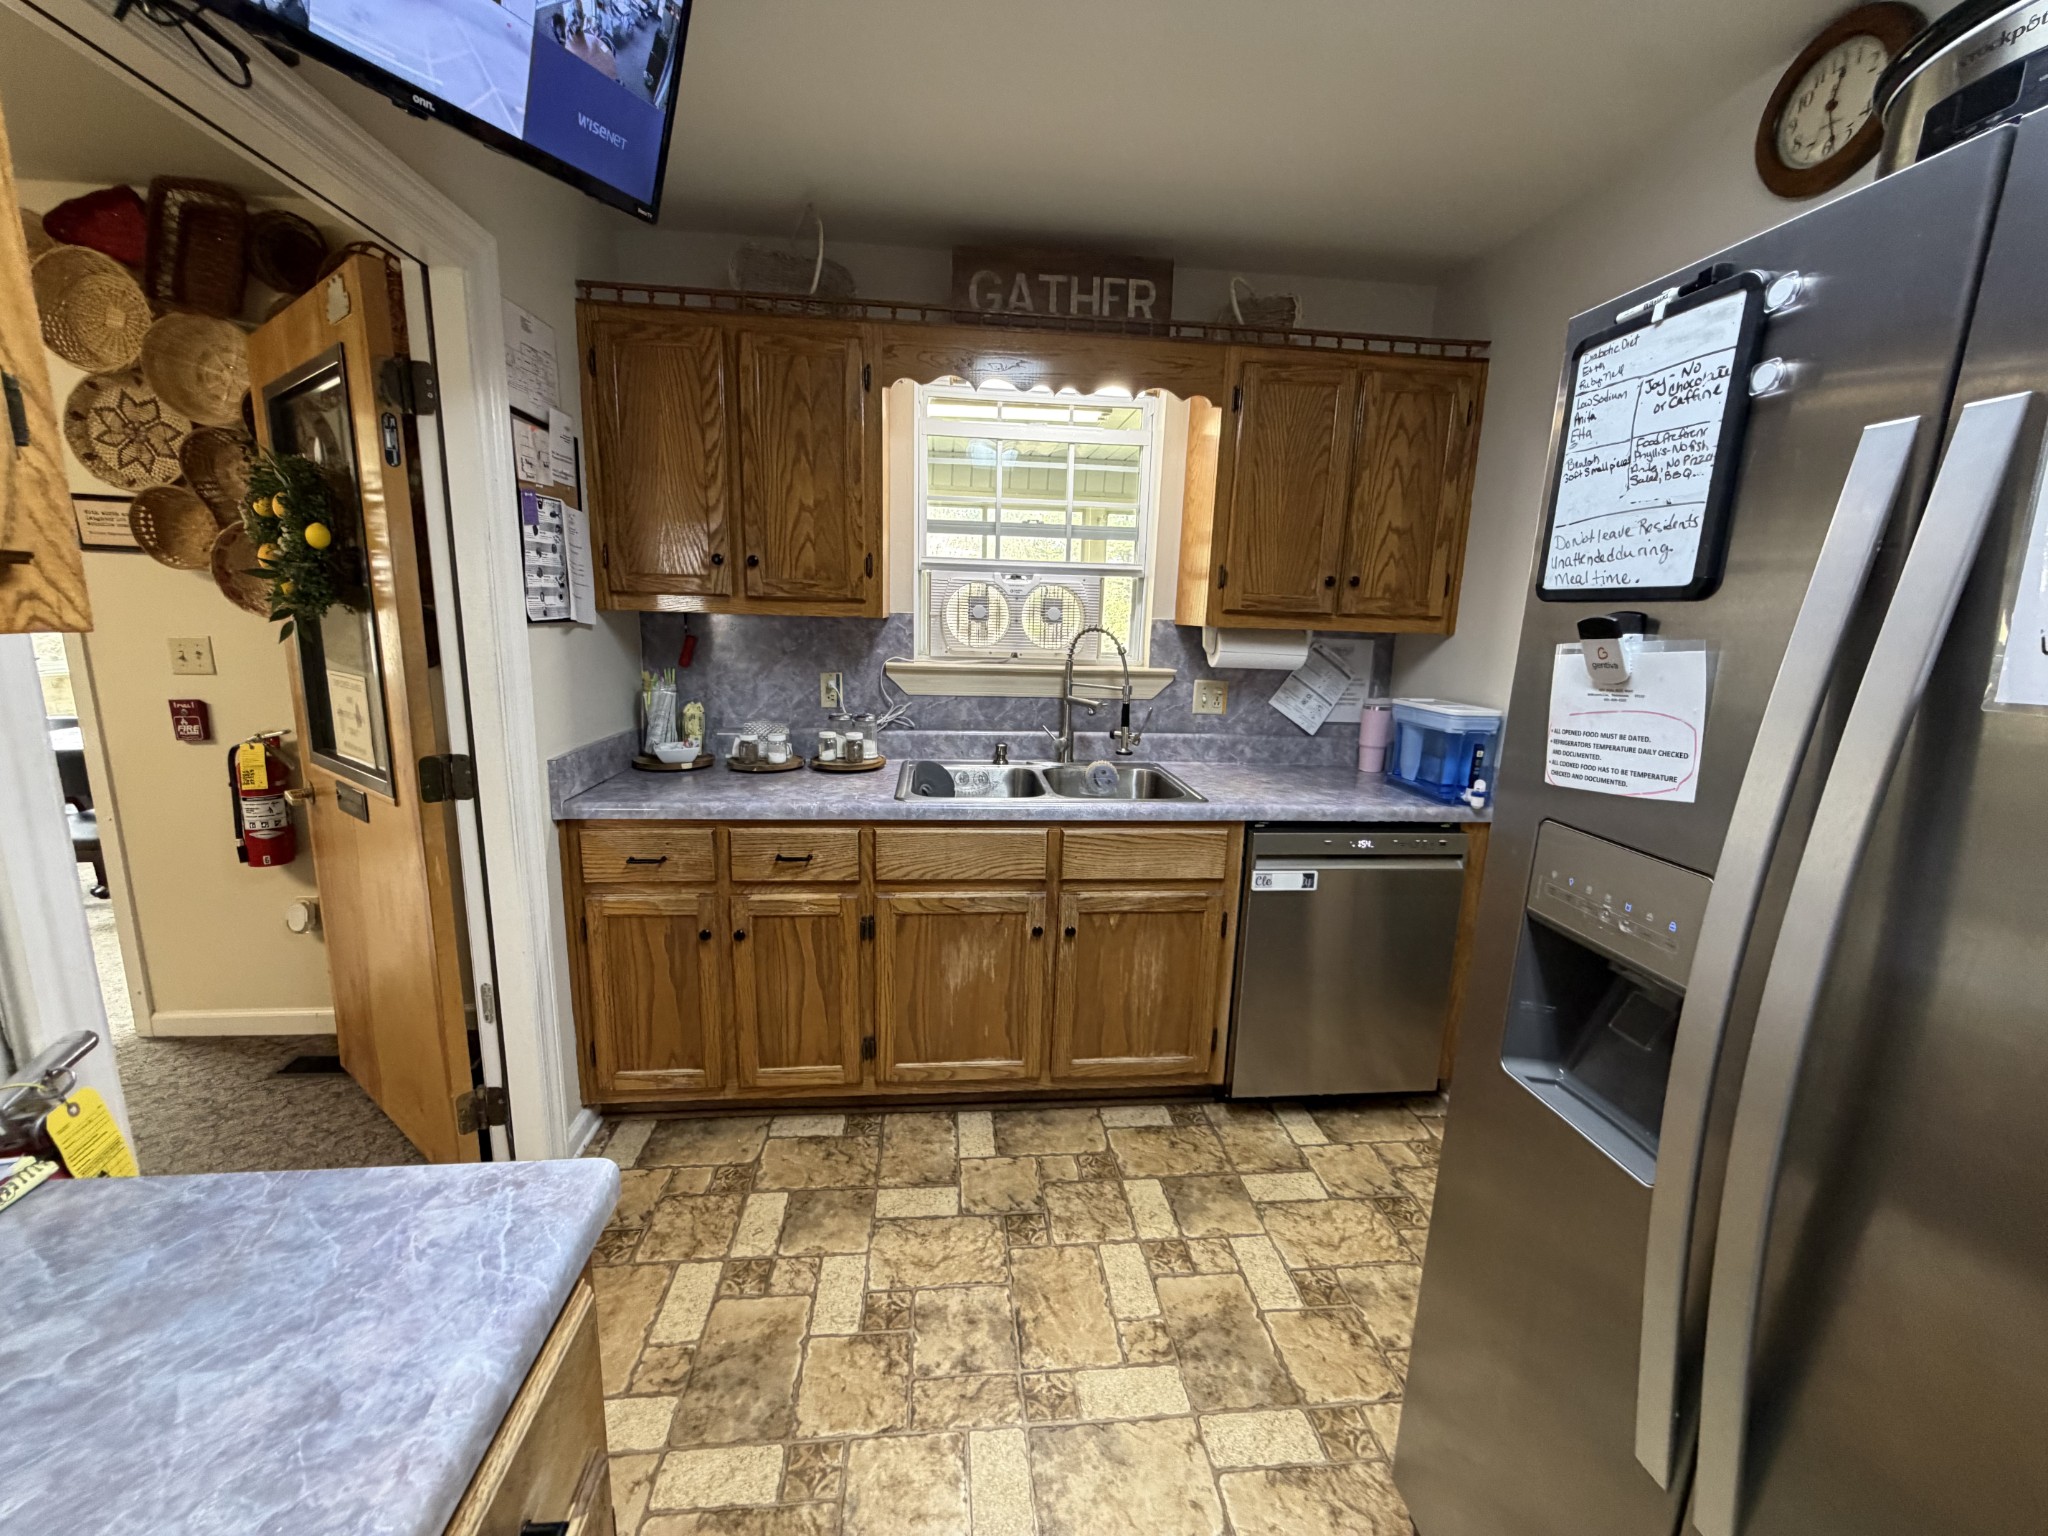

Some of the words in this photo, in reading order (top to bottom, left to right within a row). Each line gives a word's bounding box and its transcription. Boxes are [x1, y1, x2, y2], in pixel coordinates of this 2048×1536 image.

[968, 270, 1157, 319] GATHER
[1681, 361, 1702, 378] No
[1597, 526, 1636, 544] leave
[177, 724, 200, 732] FIRE
[1600, 732, 1618, 740] MUST
[1628, 734, 1651, 743] DATED.
[1562, 750, 1602, 761] DOCUMENTED.
[1593, 743, 1637, 754] TEMPERATURE
[1637, 747, 1657, 755] DAILY
[1657, 750, 1689, 760] CHECKED
[1560, 760, 1579, 769] COOKED
[1630, 770, 1678, 783] TEMPERATURE
[1584, 775, 1628, 787] DOCUMENTED.
